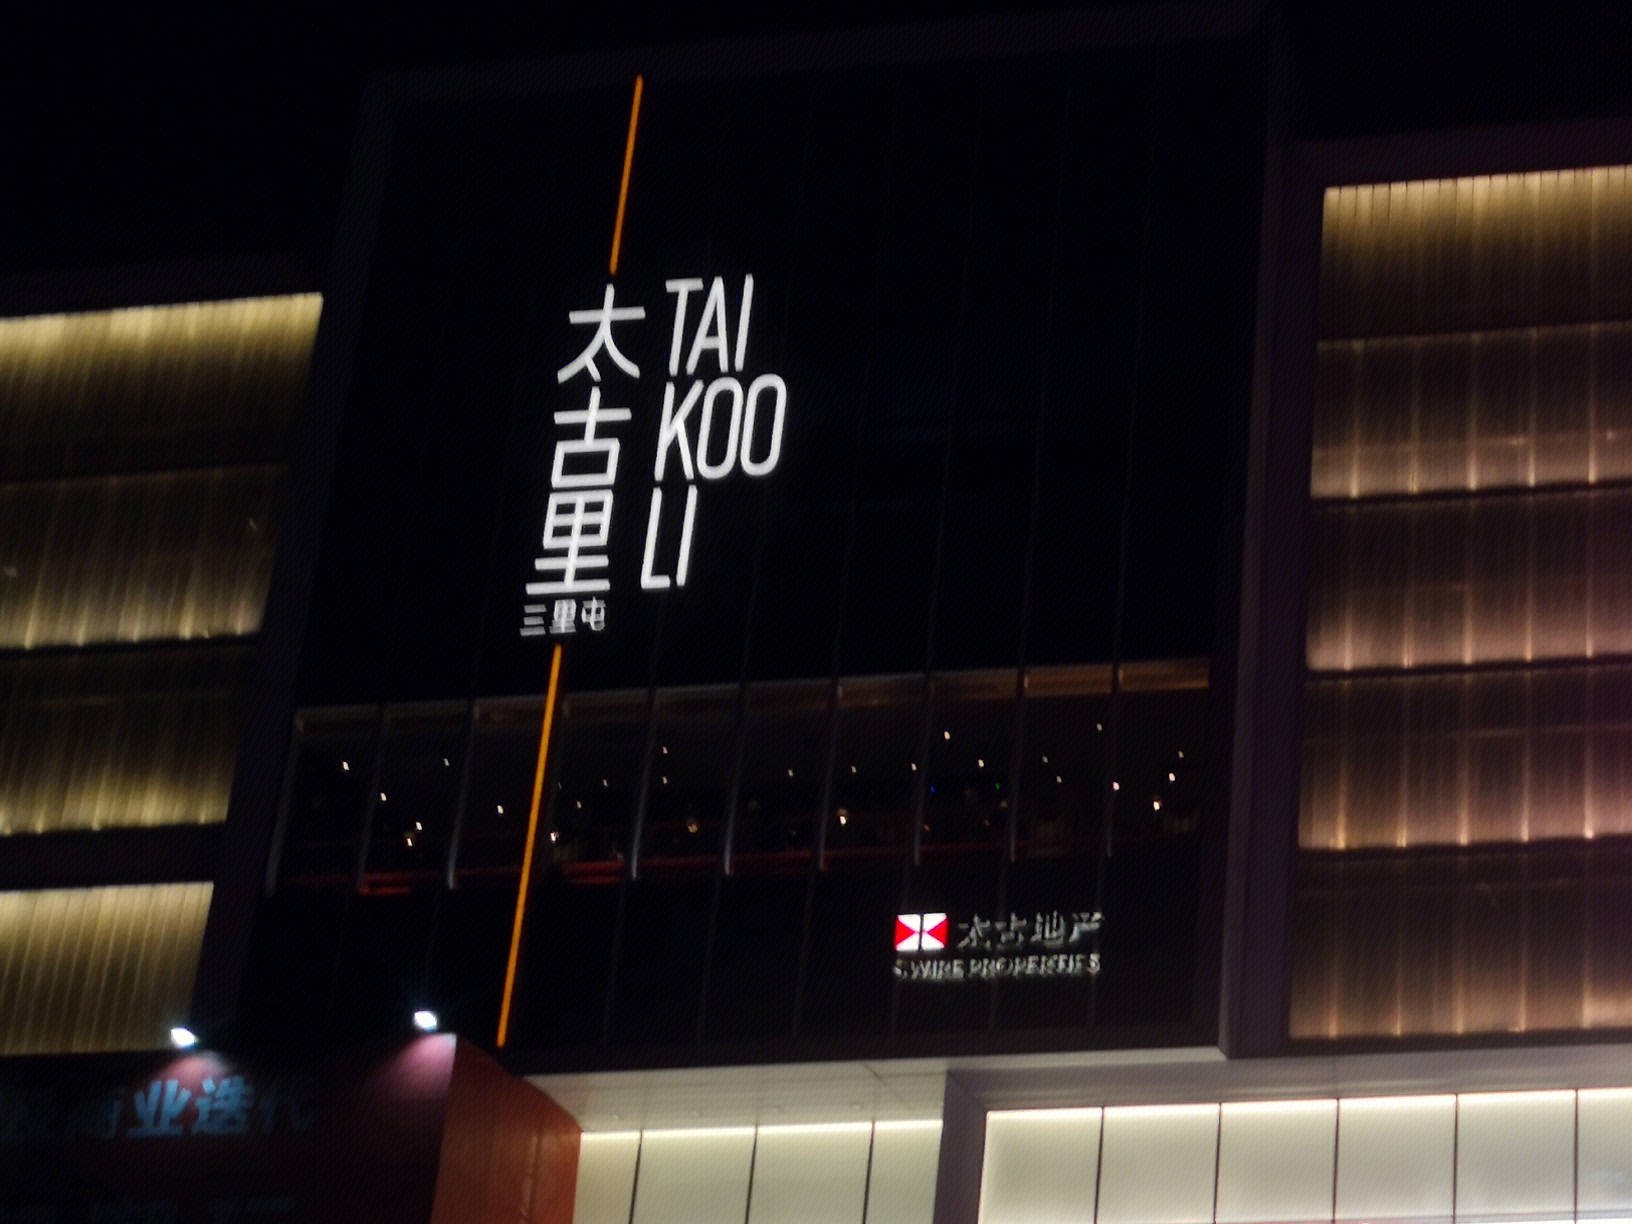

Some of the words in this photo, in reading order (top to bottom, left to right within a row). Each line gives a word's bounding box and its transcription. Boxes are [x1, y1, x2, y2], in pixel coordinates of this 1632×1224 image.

[665, 273, 754, 376] TAI
[525, 283, 646, 595] 太古里
[654, 373, 787, 481] KOO
[640, 484, 698, 590] LI
[519, 596, 606, 636] 三里屯
